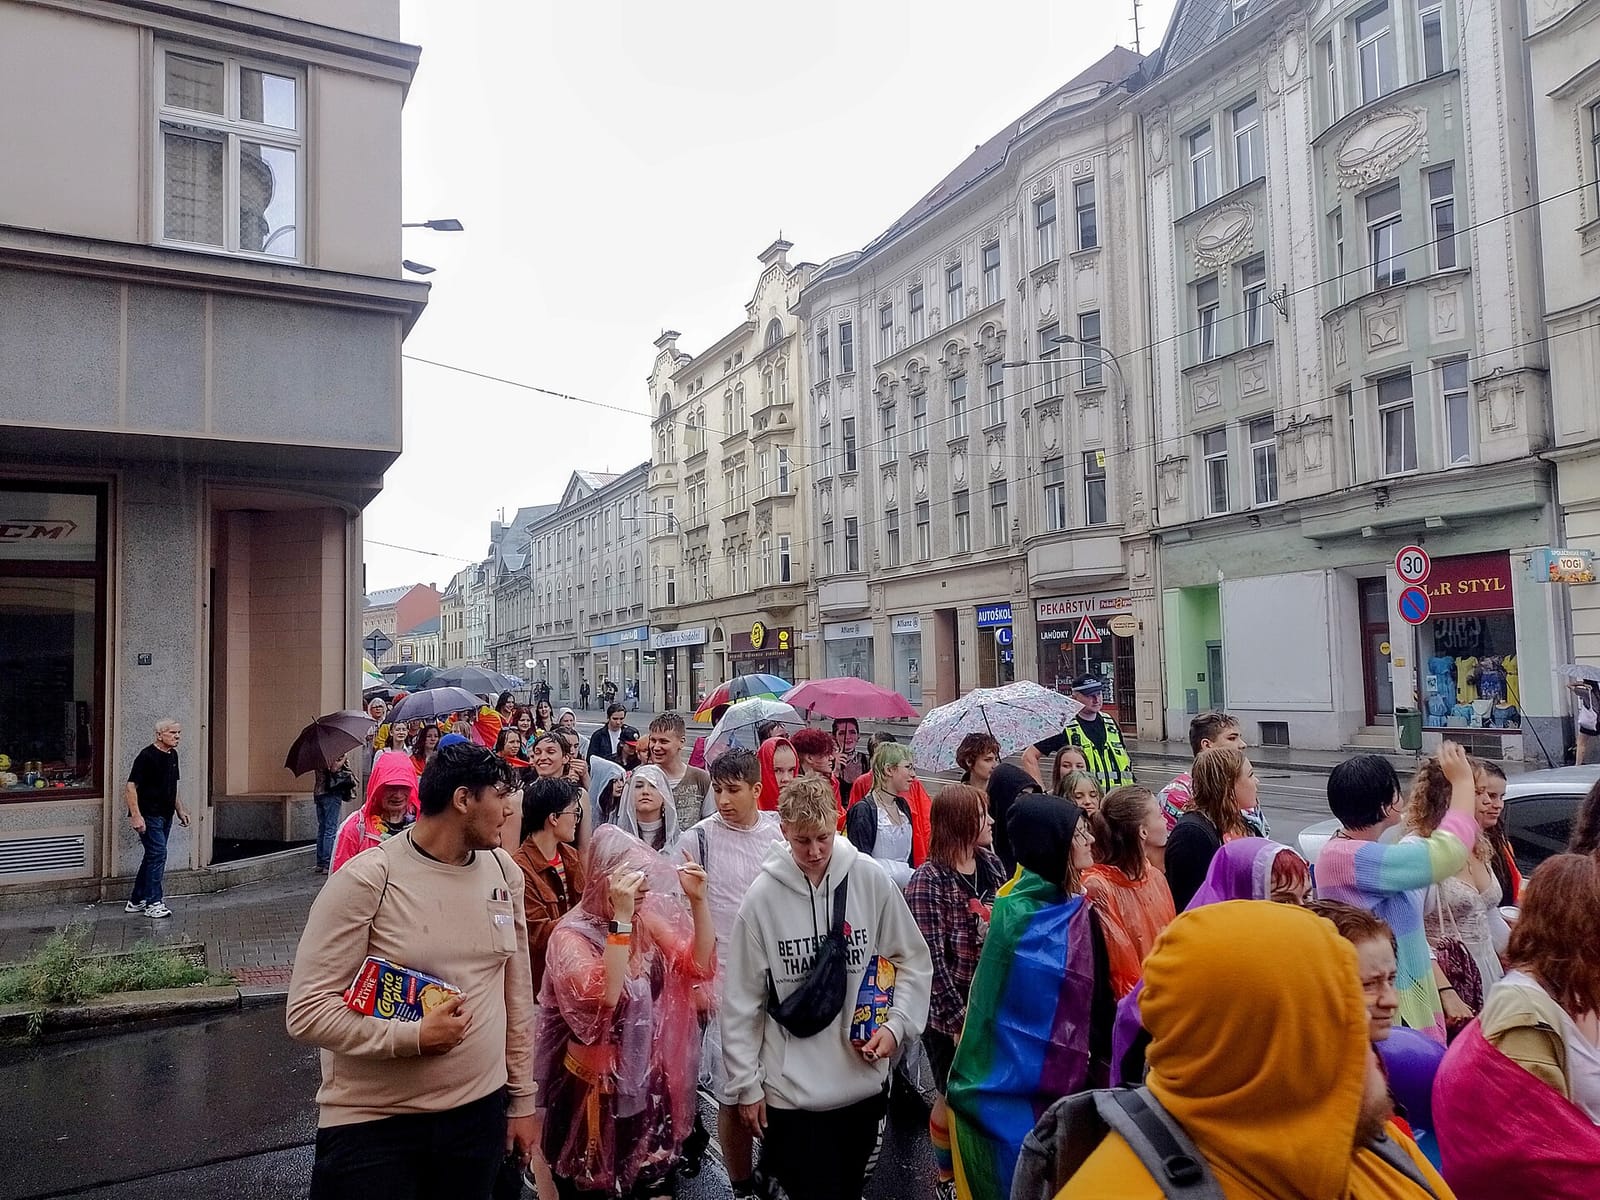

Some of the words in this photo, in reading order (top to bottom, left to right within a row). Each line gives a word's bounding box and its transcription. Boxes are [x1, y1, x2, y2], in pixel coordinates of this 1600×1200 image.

[1403, 556, 1423, 574] 30
[1458, 577, 1506, 594] STYL
[1040, 597, 1095, 616] PEKAŘSTVÍ
[896, 619, 912, 628] Allianz
[1002, 631, 1009, 642] L
[1040, 630, 1069, 640] LAHŮDKY
[845, 928, 868, 947] AFE
[363, 977, 377, 1000] LITRE
[377, 972, 395, 1017] Caprio
[391, 975, 404, 1003] plus
[353, 998, 366, 1009] 2
